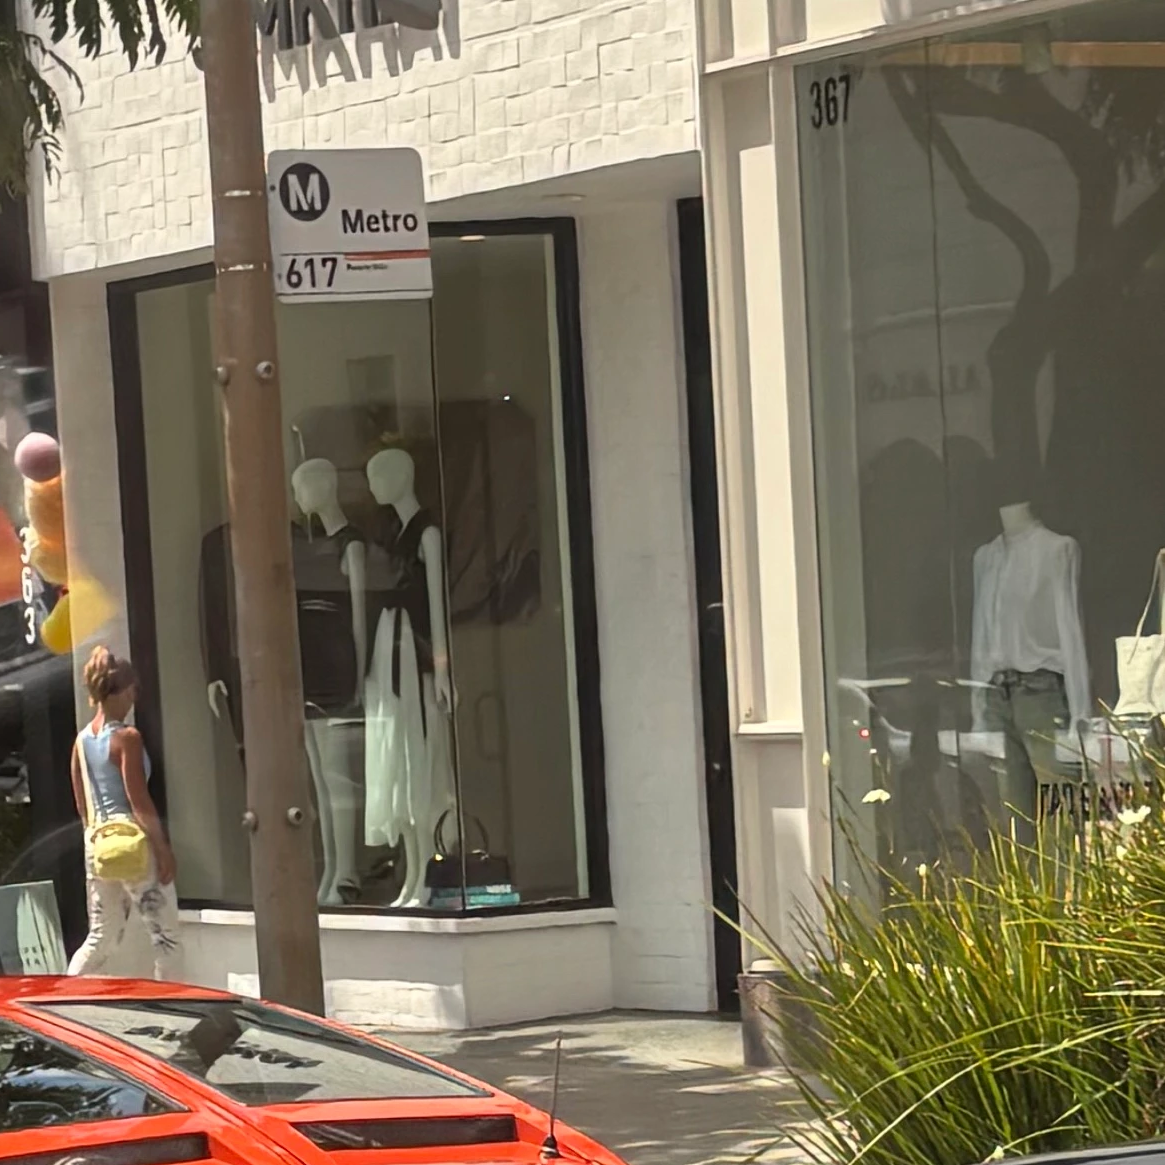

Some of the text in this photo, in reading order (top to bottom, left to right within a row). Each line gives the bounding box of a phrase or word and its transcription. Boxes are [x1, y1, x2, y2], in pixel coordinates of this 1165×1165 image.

[810, 74, 850, 130] 367
[286, 172, 323, 212] M
[341, 208, 418, 234] Metro
[286, 256, 338, 288] 617
[19, 526, 36, 644] 363
